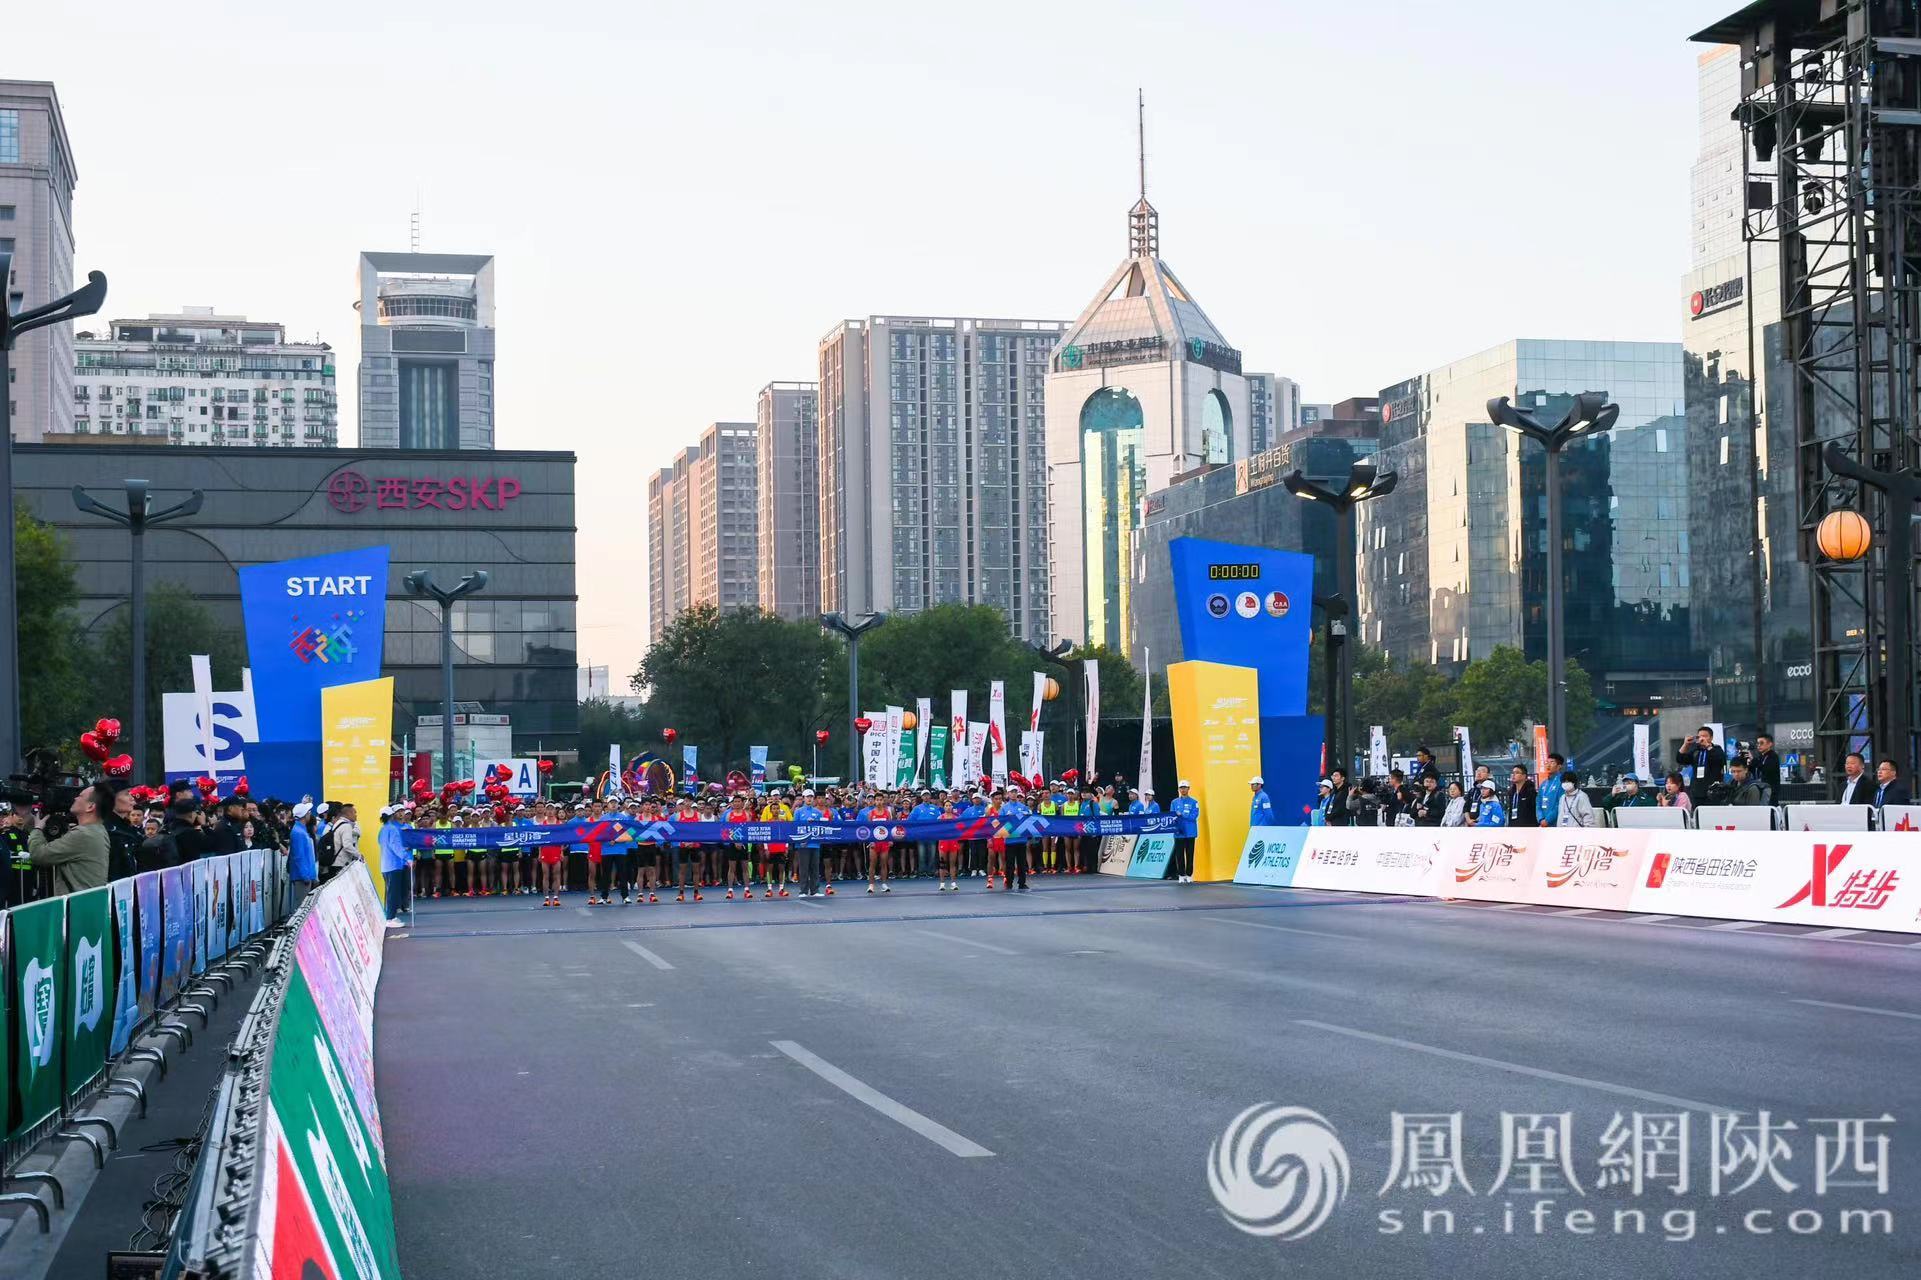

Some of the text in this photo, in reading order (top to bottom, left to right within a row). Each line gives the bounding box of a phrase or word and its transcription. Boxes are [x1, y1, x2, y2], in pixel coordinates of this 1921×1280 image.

[1249, 444, 1290, 476] 王府井百货
[375, 476, 522, 511] 西安SKP
[1210, 564, 1259, 578] 0:00:00
[286, 575, 372, 597] START
[1786, 663, 1812, 678] ecco
[195, 702, 244, 762] S
[1790, 728, 1814, 740] ecco
[110, 763, 131, 775] 6:00
[518, 762, 532, 788] A
[1266, 842, 1287, 854] WORLD
[1468, 843, 1514, 873] 星河湾
[1262, 856, 1291, 868] ATHLETICS
[1560, 844, 1614, 878] 星河湾
[1671, 856, 1758, 878] 陕西省田径协会
[1828, 869, 1901, 910] 特步
